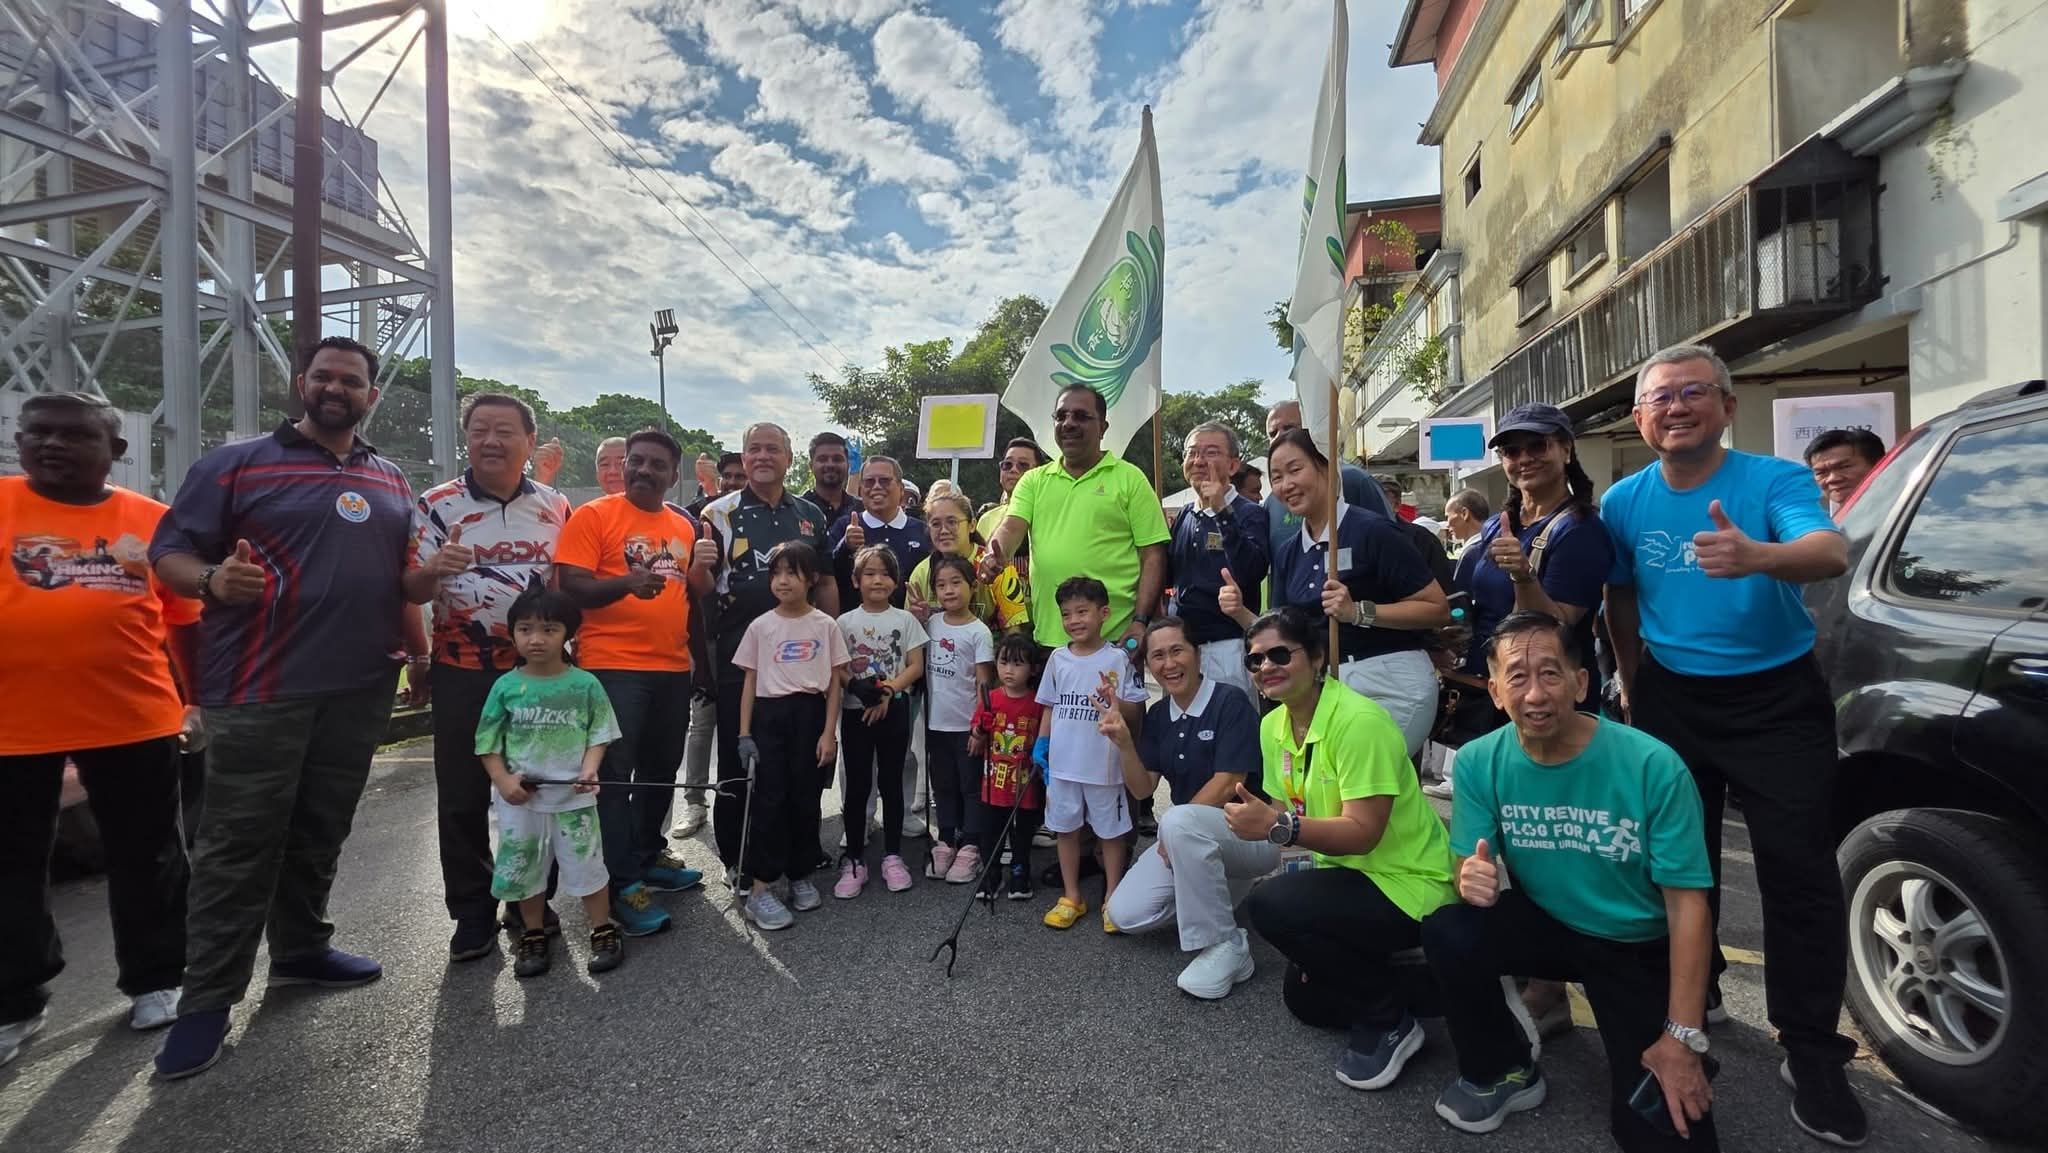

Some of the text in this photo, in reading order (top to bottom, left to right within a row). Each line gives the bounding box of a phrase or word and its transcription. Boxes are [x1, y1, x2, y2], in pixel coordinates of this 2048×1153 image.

[1069, 708, 1100, 722] BETTER
[1501, 805, 1609, 825] CITY REVIVE
[1553, 822, 1583, 839] FOR
[1586, 829, 1600, 843] A
[1512, 838, 1592, 853] CLEANER URBAN
